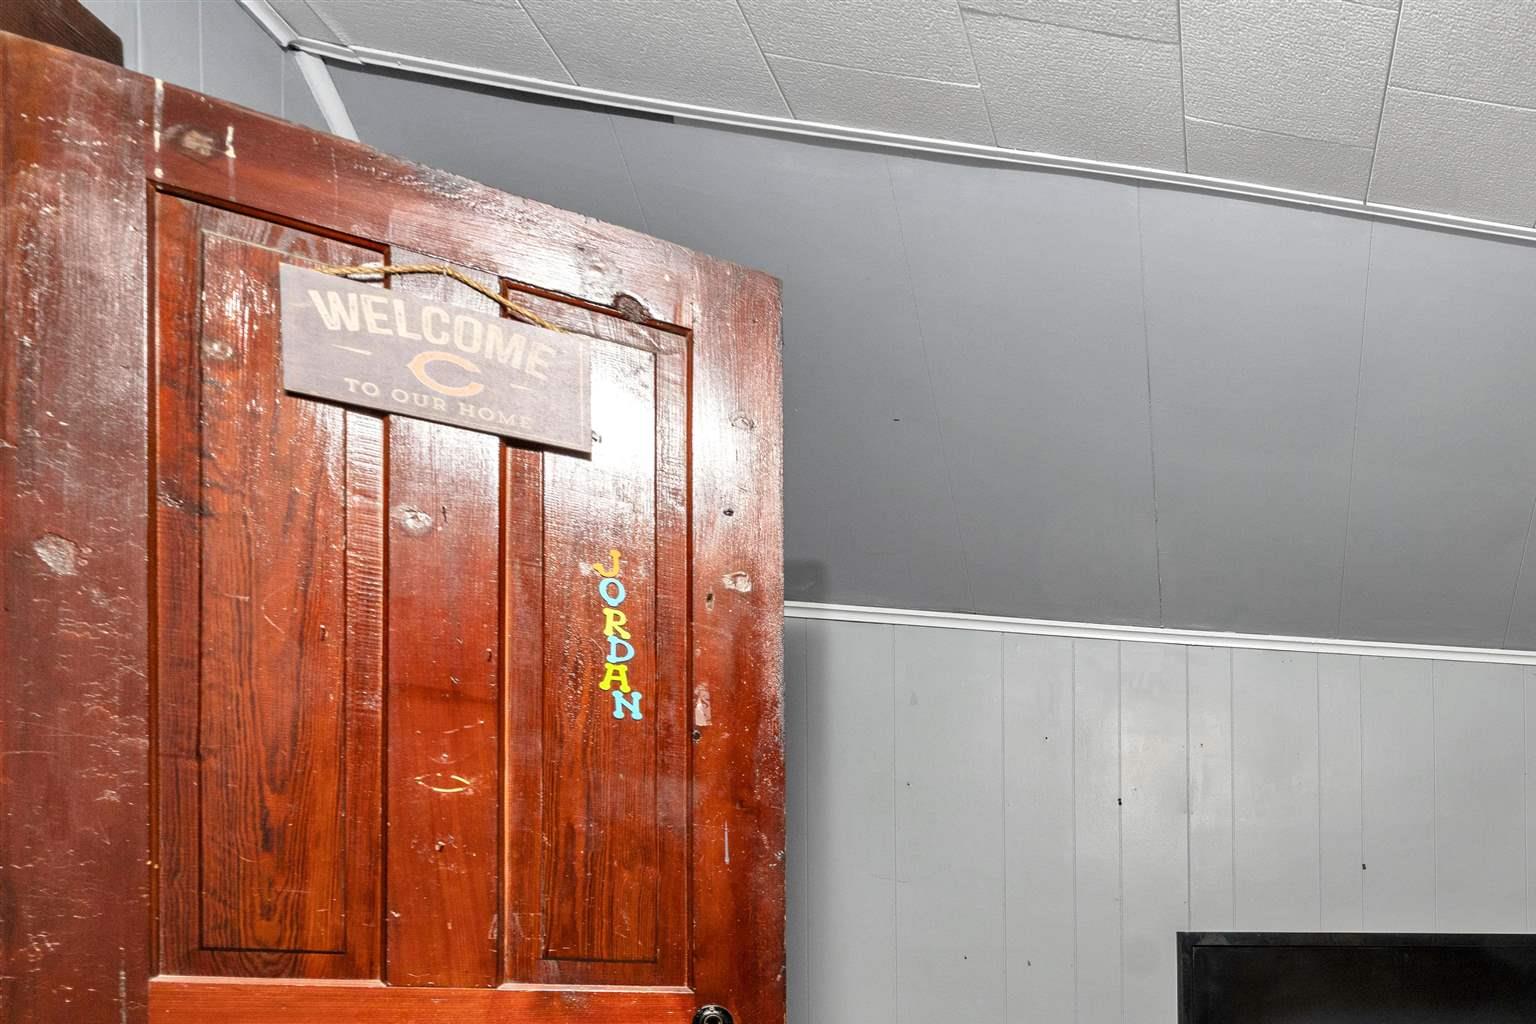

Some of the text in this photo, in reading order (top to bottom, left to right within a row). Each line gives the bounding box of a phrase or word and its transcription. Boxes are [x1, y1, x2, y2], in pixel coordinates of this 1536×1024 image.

[308, 289, 550, 381] WELCOME
[344, 377, 534, 429] TO OUR HOME
